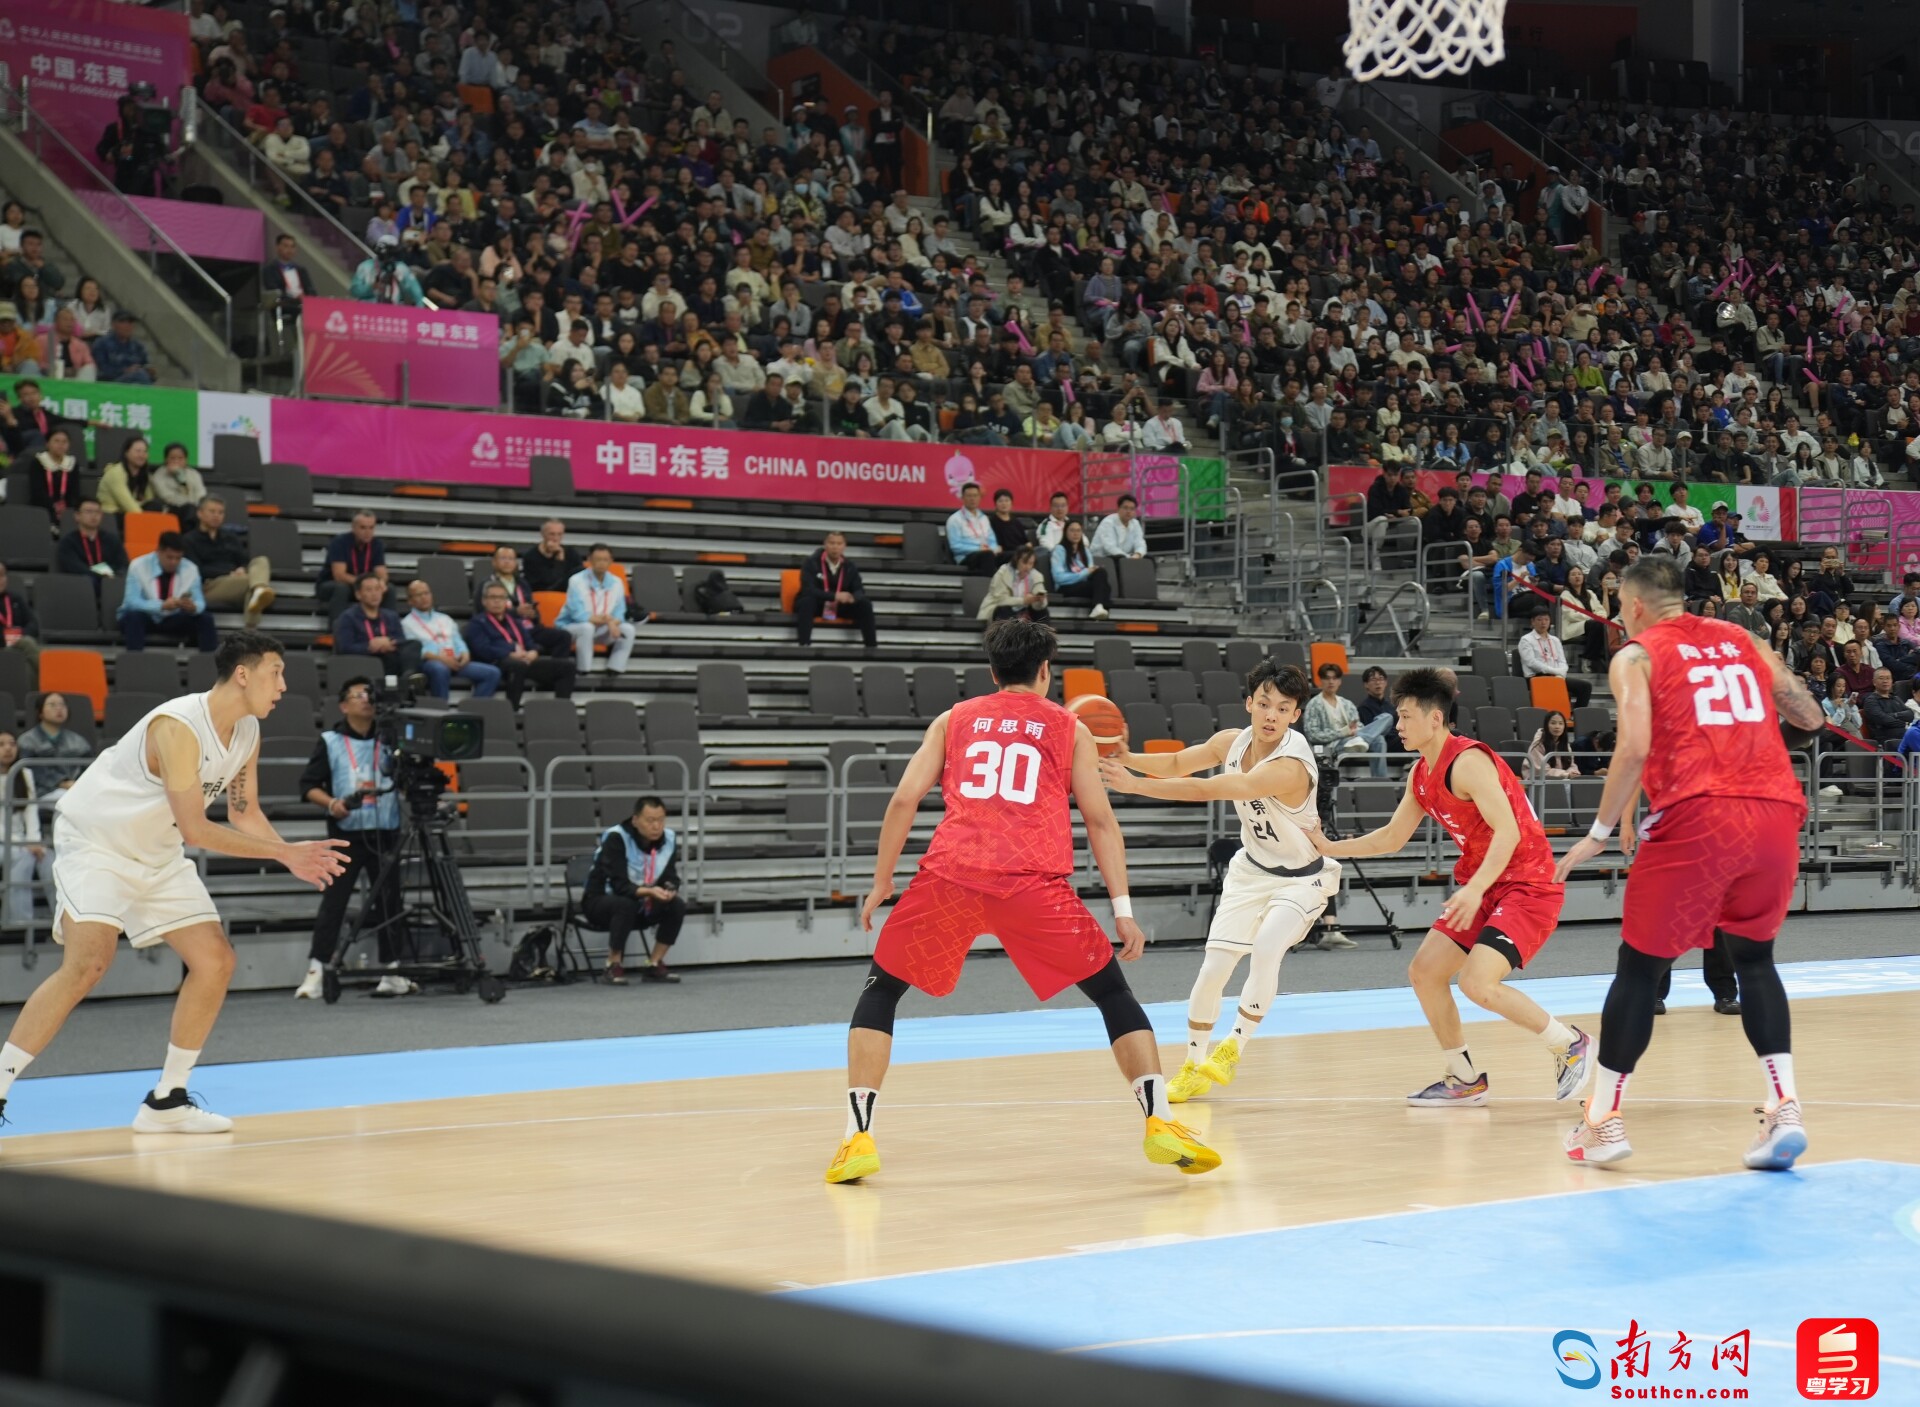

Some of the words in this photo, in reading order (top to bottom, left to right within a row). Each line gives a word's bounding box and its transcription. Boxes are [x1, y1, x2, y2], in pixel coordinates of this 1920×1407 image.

[30, 53, 129, 89] 中国·东莞
[596, 440, 729, 479] 中国·东莞
[744, 455, 808, 477] CHINA
[816, 459, 926, 483] DONGGUAN
[1687, 663, 1766, 726] 20
[972, 717, 1046, 740] 何思雨
[960, 740, 1042, 805] 30
[1249, 818, 1280, 842] 24
